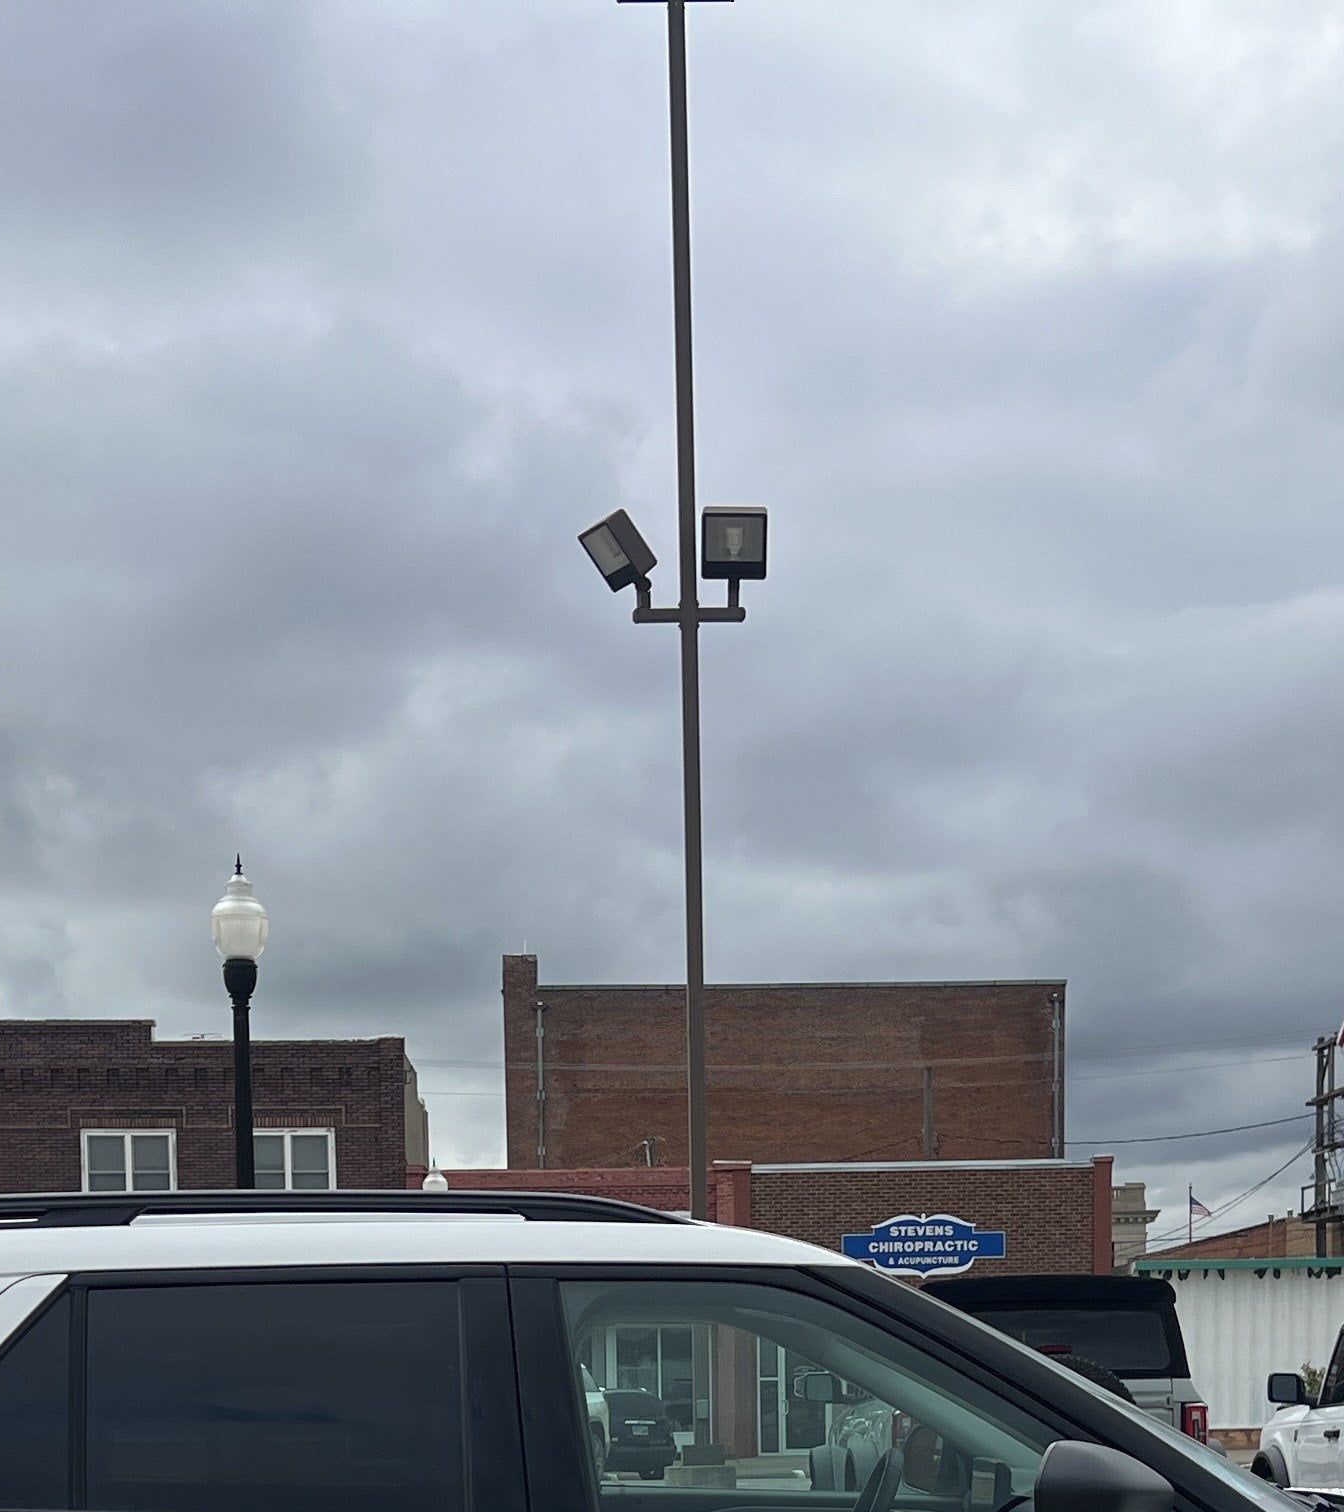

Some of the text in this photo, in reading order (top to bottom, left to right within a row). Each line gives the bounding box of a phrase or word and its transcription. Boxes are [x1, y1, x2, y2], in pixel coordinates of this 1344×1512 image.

[889, 1226, 954, 1237] STEVENS
[868, 1240, 979, 1253] CHIROPRACTIC
[898, 1256, 960, 1265] ACUPUNCTURE
